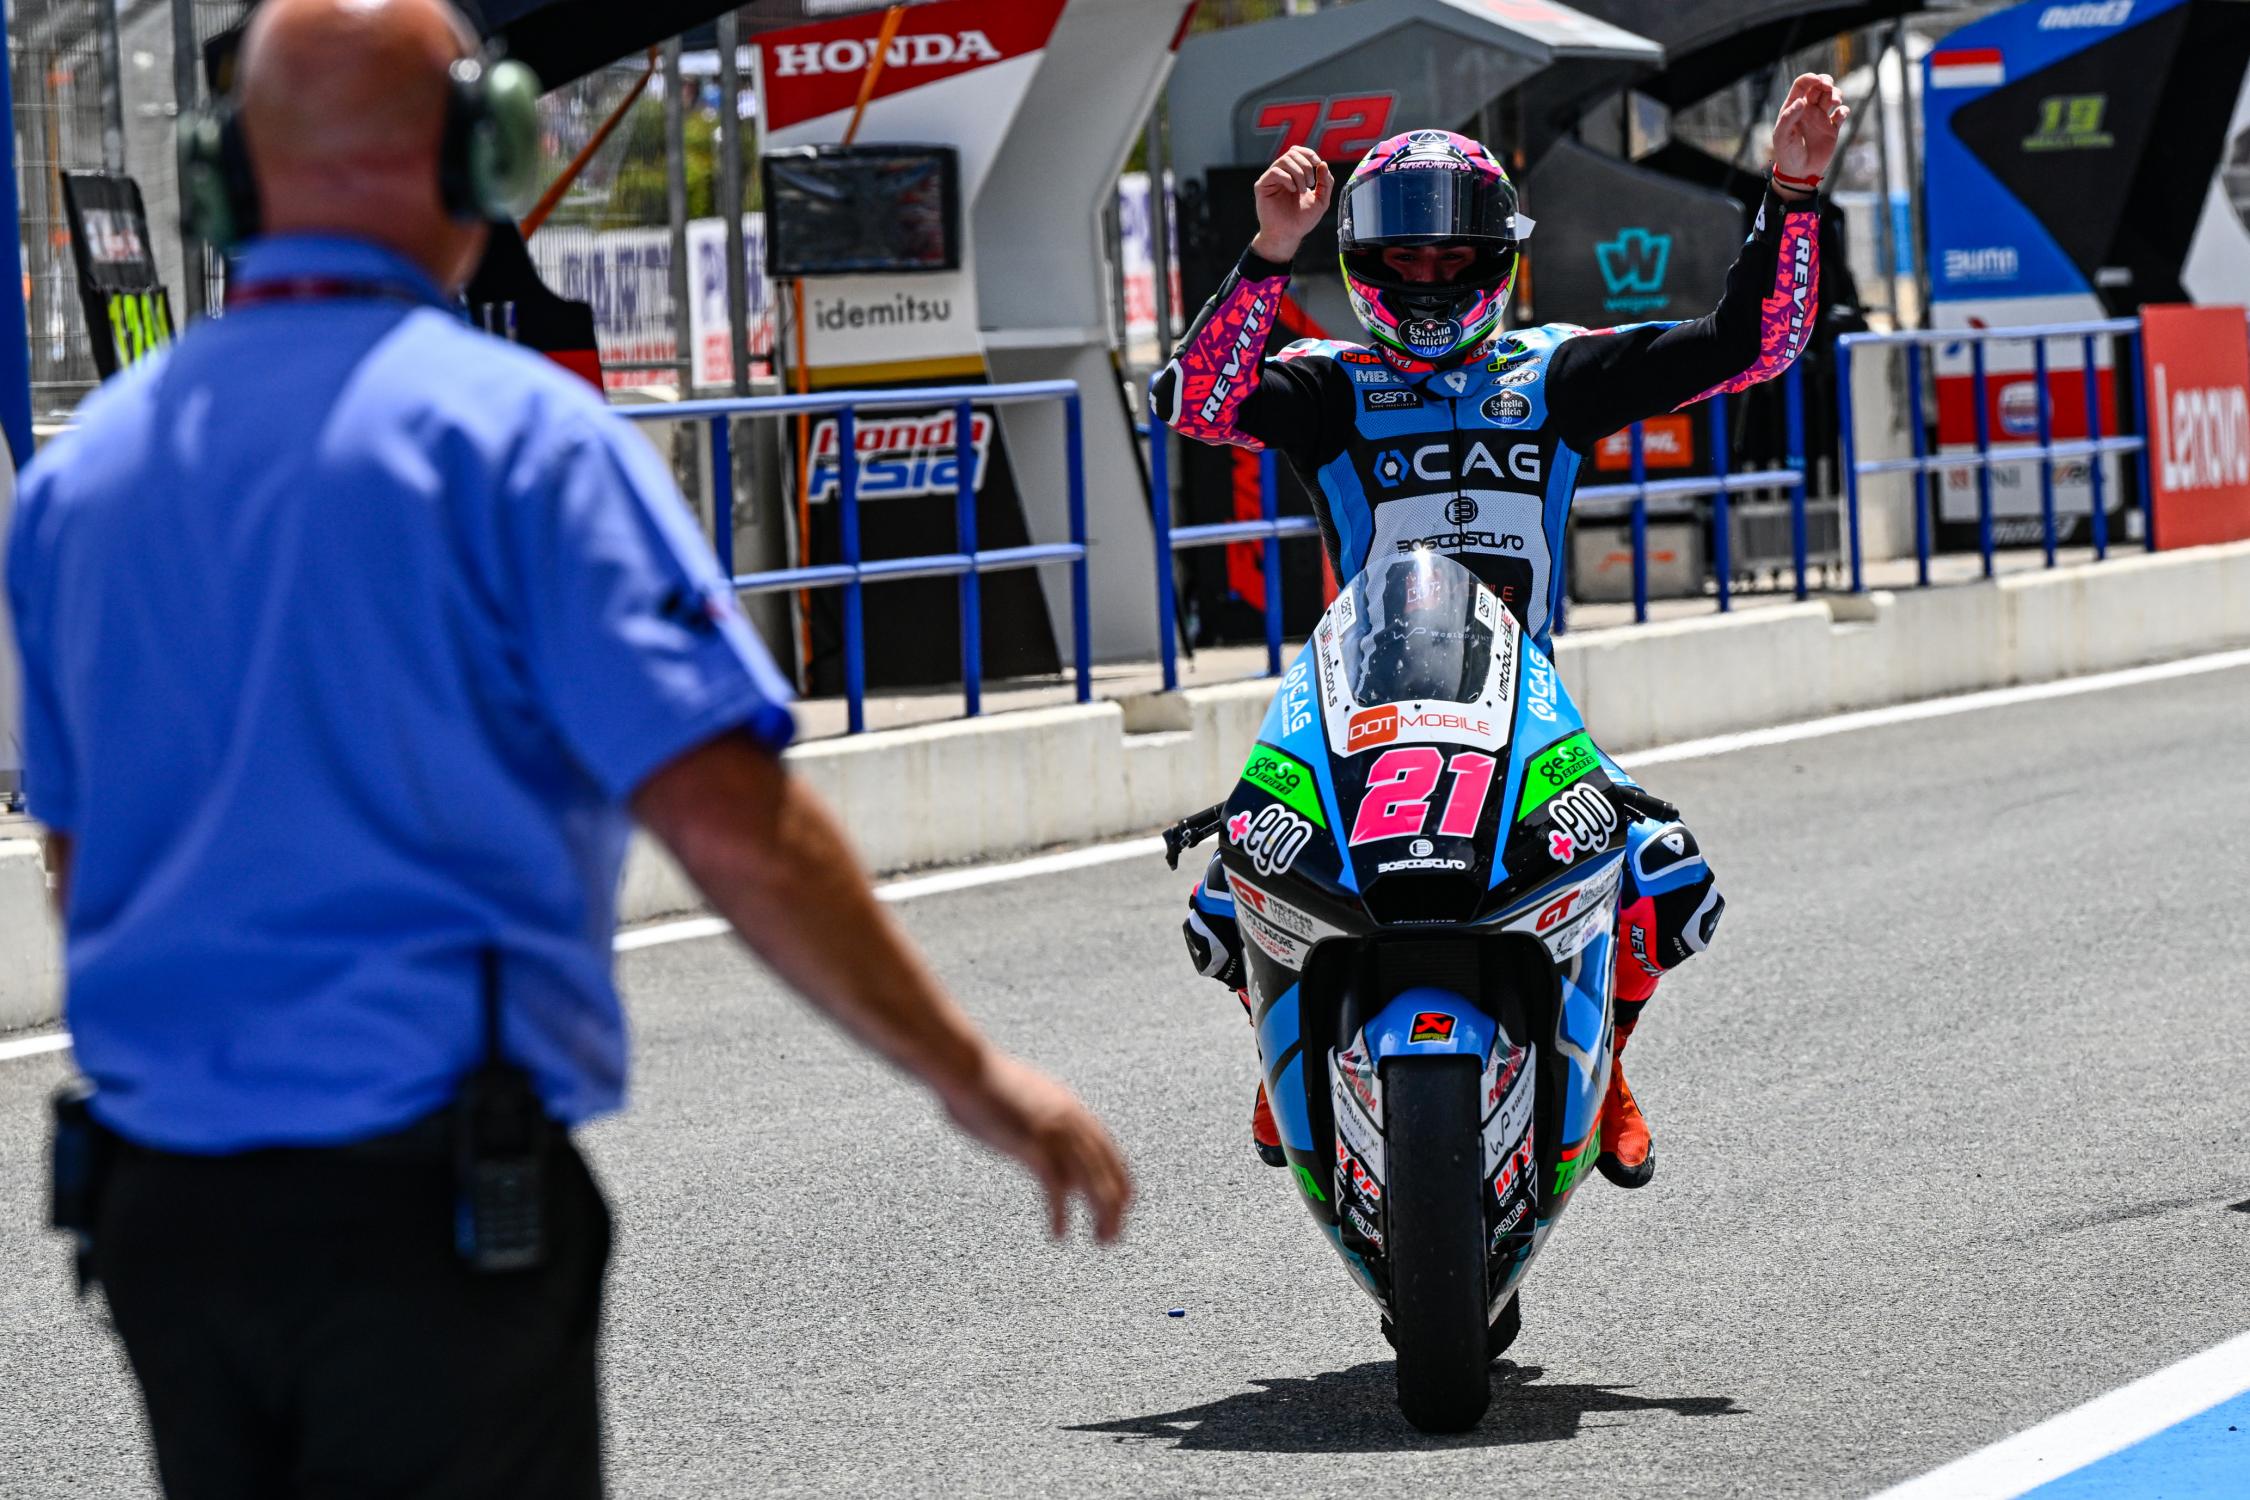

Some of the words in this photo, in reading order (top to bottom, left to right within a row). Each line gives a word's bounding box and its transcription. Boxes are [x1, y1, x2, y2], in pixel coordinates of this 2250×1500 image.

[776, 31, 1001, 77] HONDA
[1256, 94, 1395, 162] 72
[816, 294, 951, 331] idemitsu
[1784, 236, 1810, 360] REV'IT!
[1409, 324, 1451, 337] Estrella
[1409, 334, 1450, 347] Galicia
[1201, 297, 1267, 424] REV'IT!
[1368, 391, 1418, 404] esm
[1490, 399, 1524, 410] Estrella
[1491, 408, 1523, 418] Galicia
[1350, 716, 1396, 740] DOT
[1400, 713, 1491, 736] MOBILE
[1348, 747, 1496, 847] 21
[1535, 889, 1580, 932] GT
